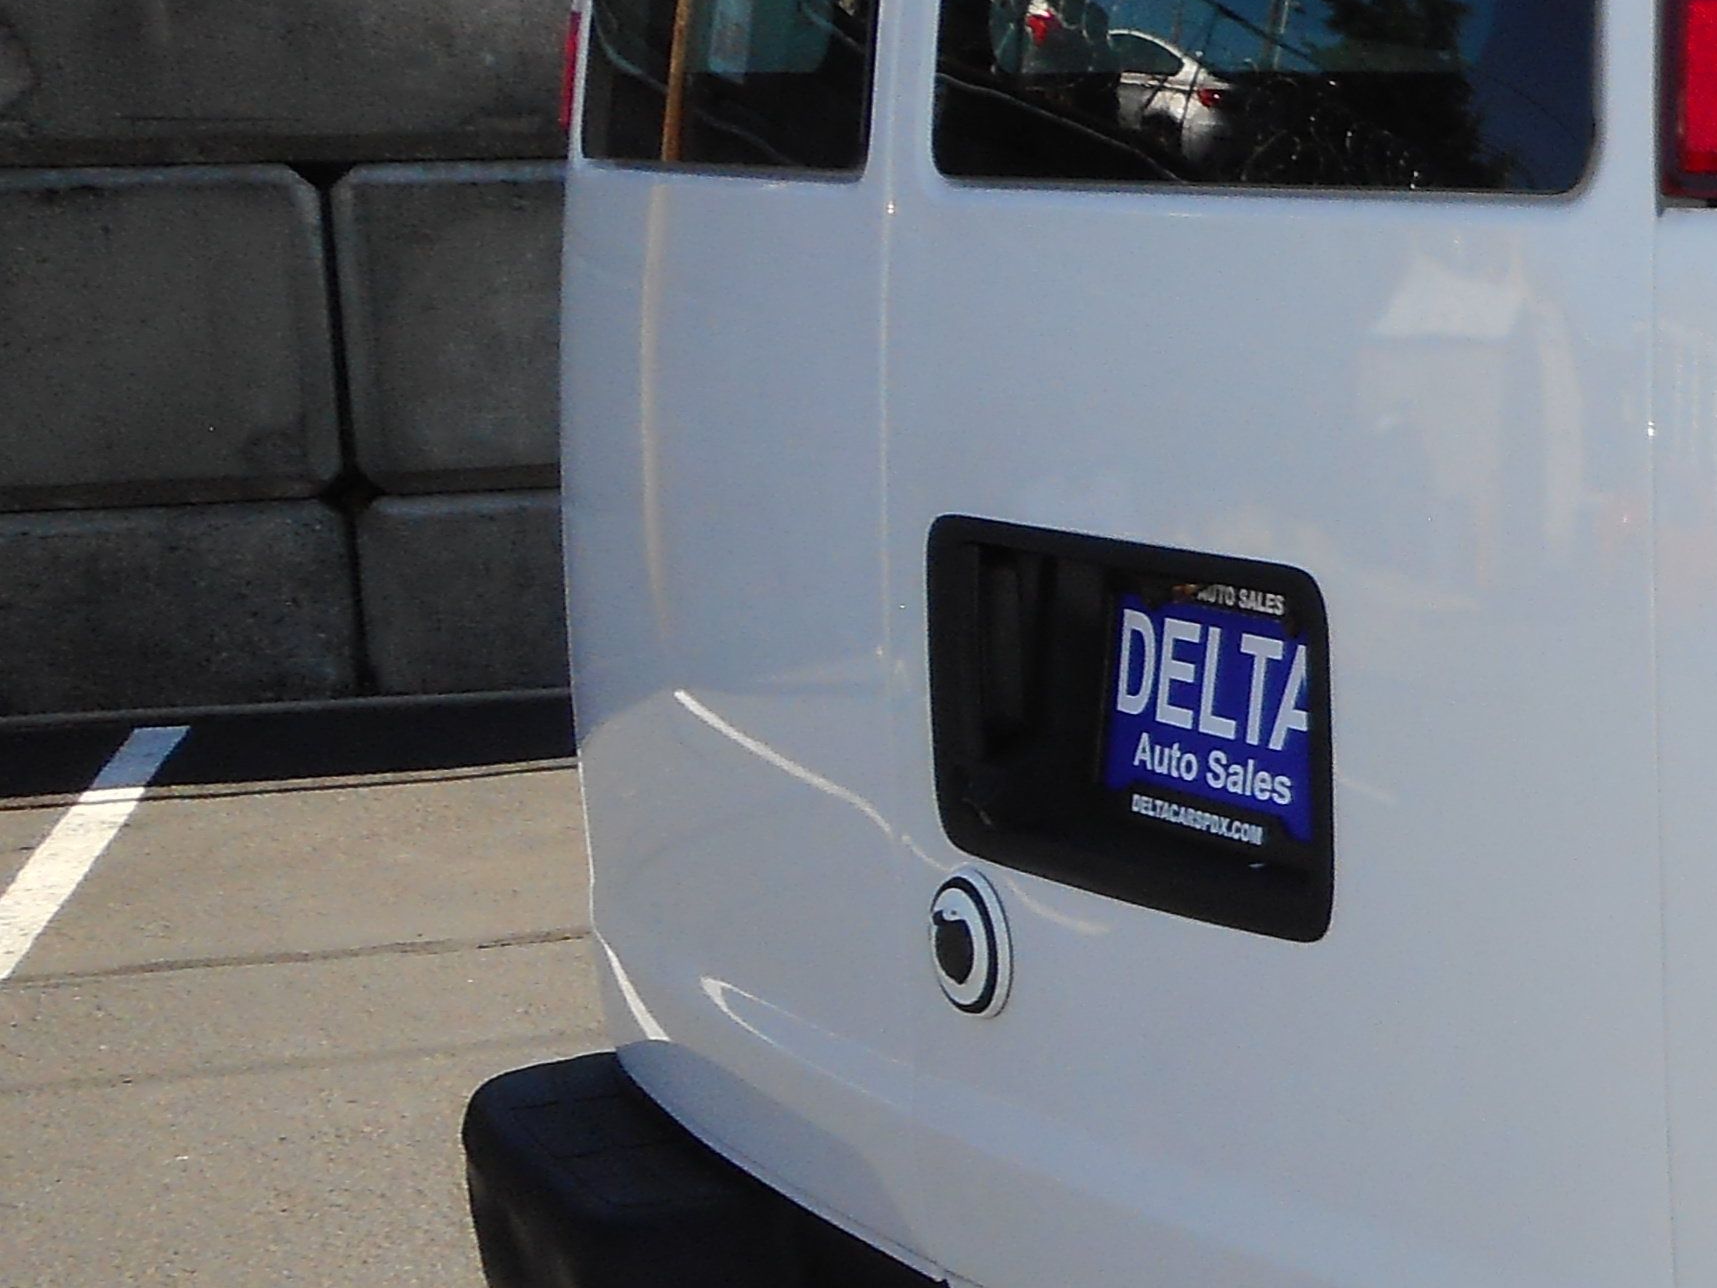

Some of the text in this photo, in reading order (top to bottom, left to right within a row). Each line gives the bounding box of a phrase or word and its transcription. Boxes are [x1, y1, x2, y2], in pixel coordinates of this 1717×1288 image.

[1238, 593, 1286, 616] SALES
[1116, 608, 1309, 751] DELTA
[1133, 731, 1292, 806] Auto Sales
